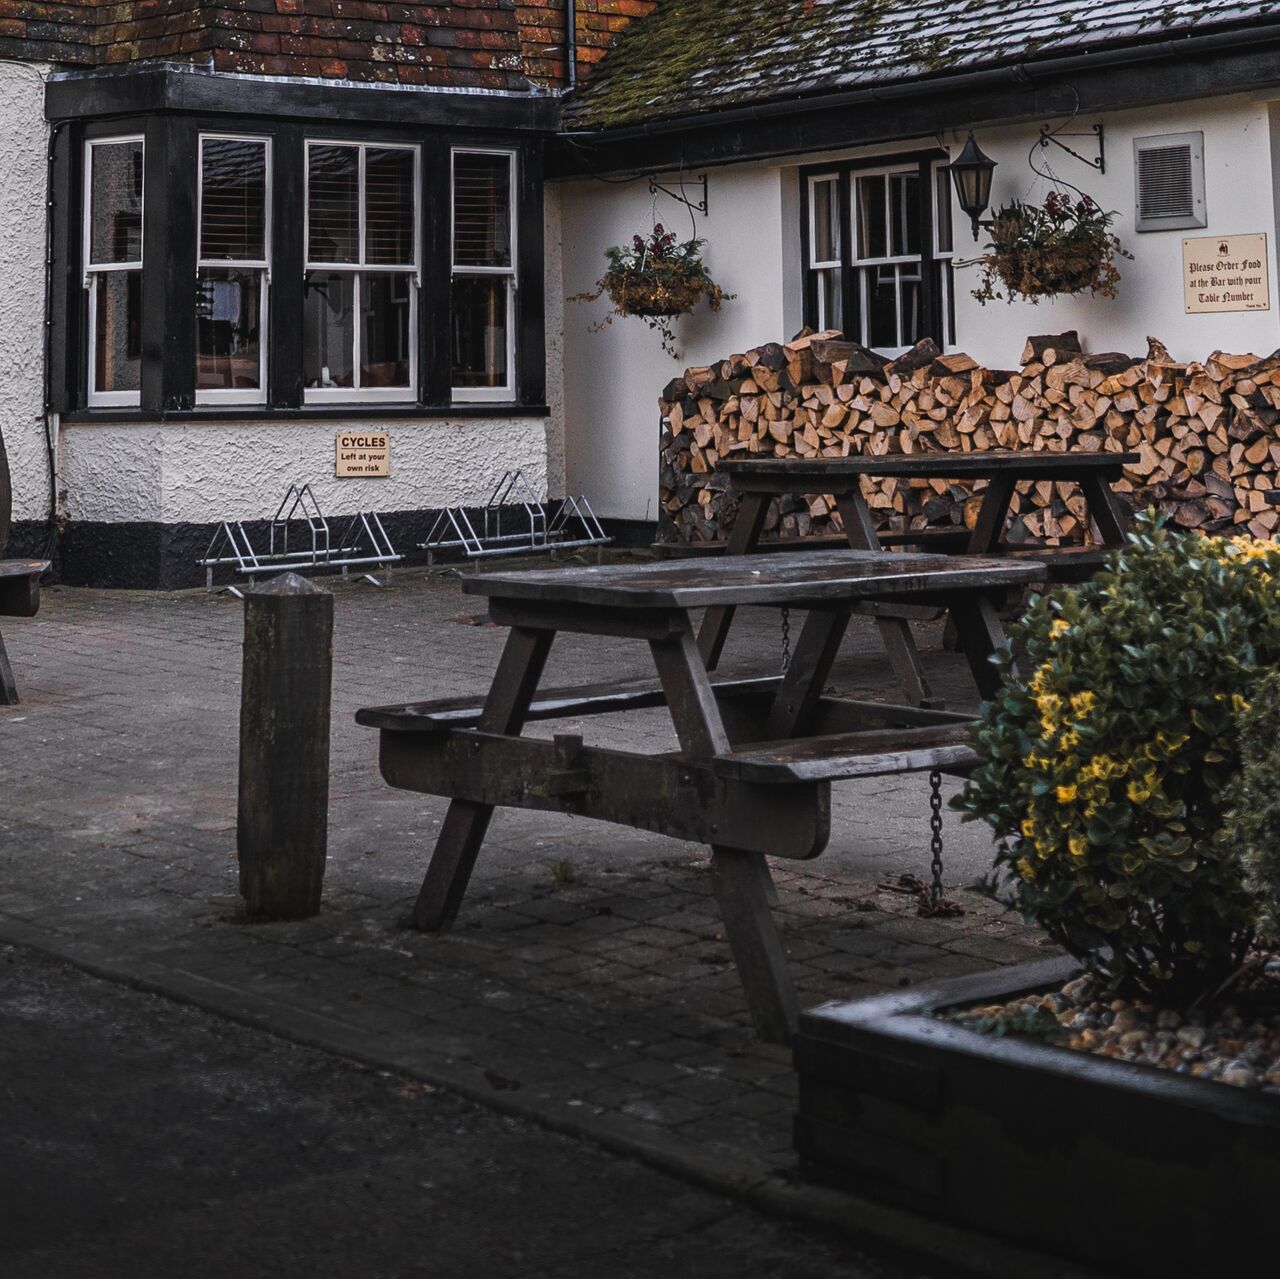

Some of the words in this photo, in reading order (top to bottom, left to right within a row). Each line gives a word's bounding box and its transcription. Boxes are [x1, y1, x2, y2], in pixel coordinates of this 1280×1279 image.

[1189, 262, 1214, 274] Please
[1216, 260, 1239, 271] Order
[1240, 259, 1261, 271] Food
[1189, 279, 1197, 288] at
[1198, 278, 1209, 288] the
[1210, 276, 1226, 287] Bar
[1227, 276, 1244, 286] with
[1244, 277, 1261, 286] your
[1198, 293, 1220, 303] Table
[1221, 292, 1254, 303] Number
[341, 437, 386, 447] CYCLES
[368, 454, 385, 462] your
[365, 464, 380, 472] risk
